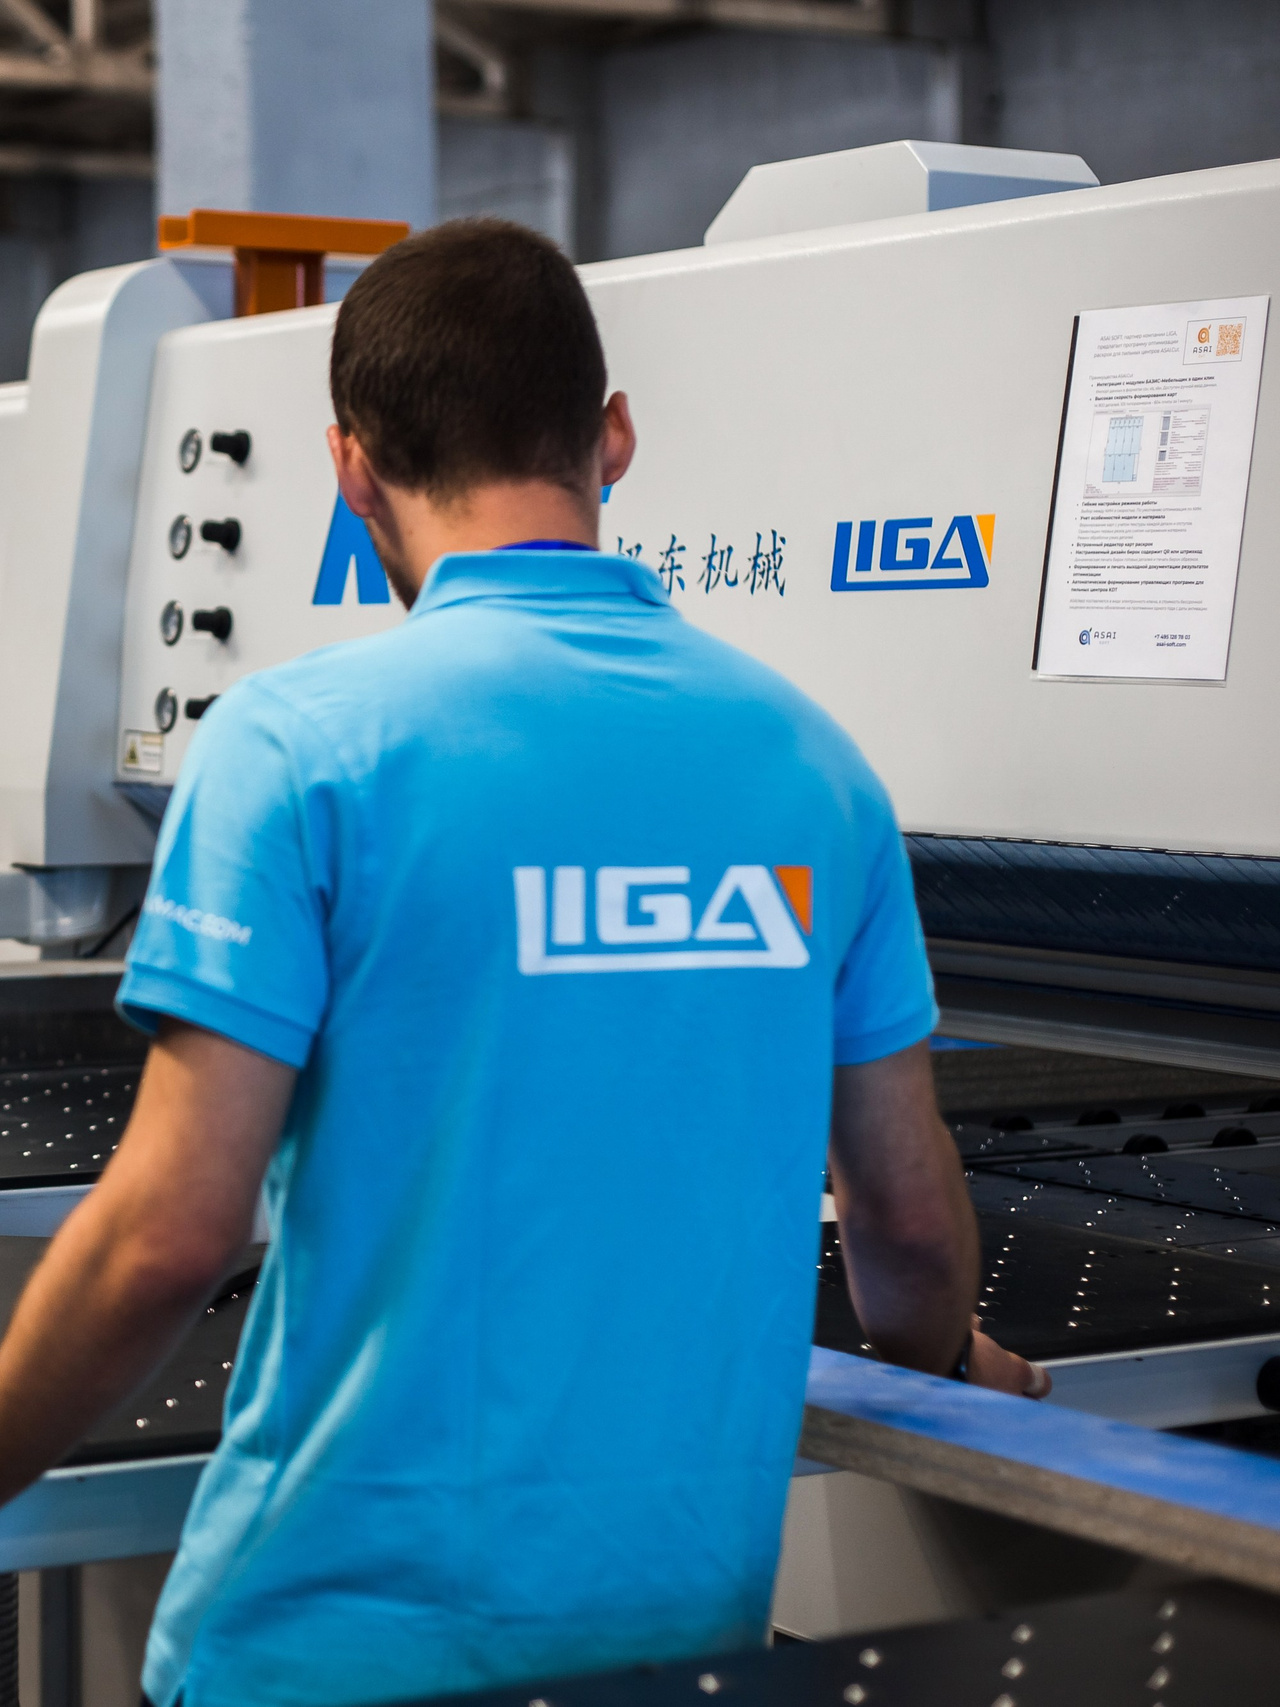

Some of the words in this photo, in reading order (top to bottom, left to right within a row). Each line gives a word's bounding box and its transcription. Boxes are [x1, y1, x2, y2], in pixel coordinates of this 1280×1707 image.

[1192, 345, 1212, 354] ASAI
[831, 515, 992, 591] LIGA
[513, 865, 812, 975] LIGA
